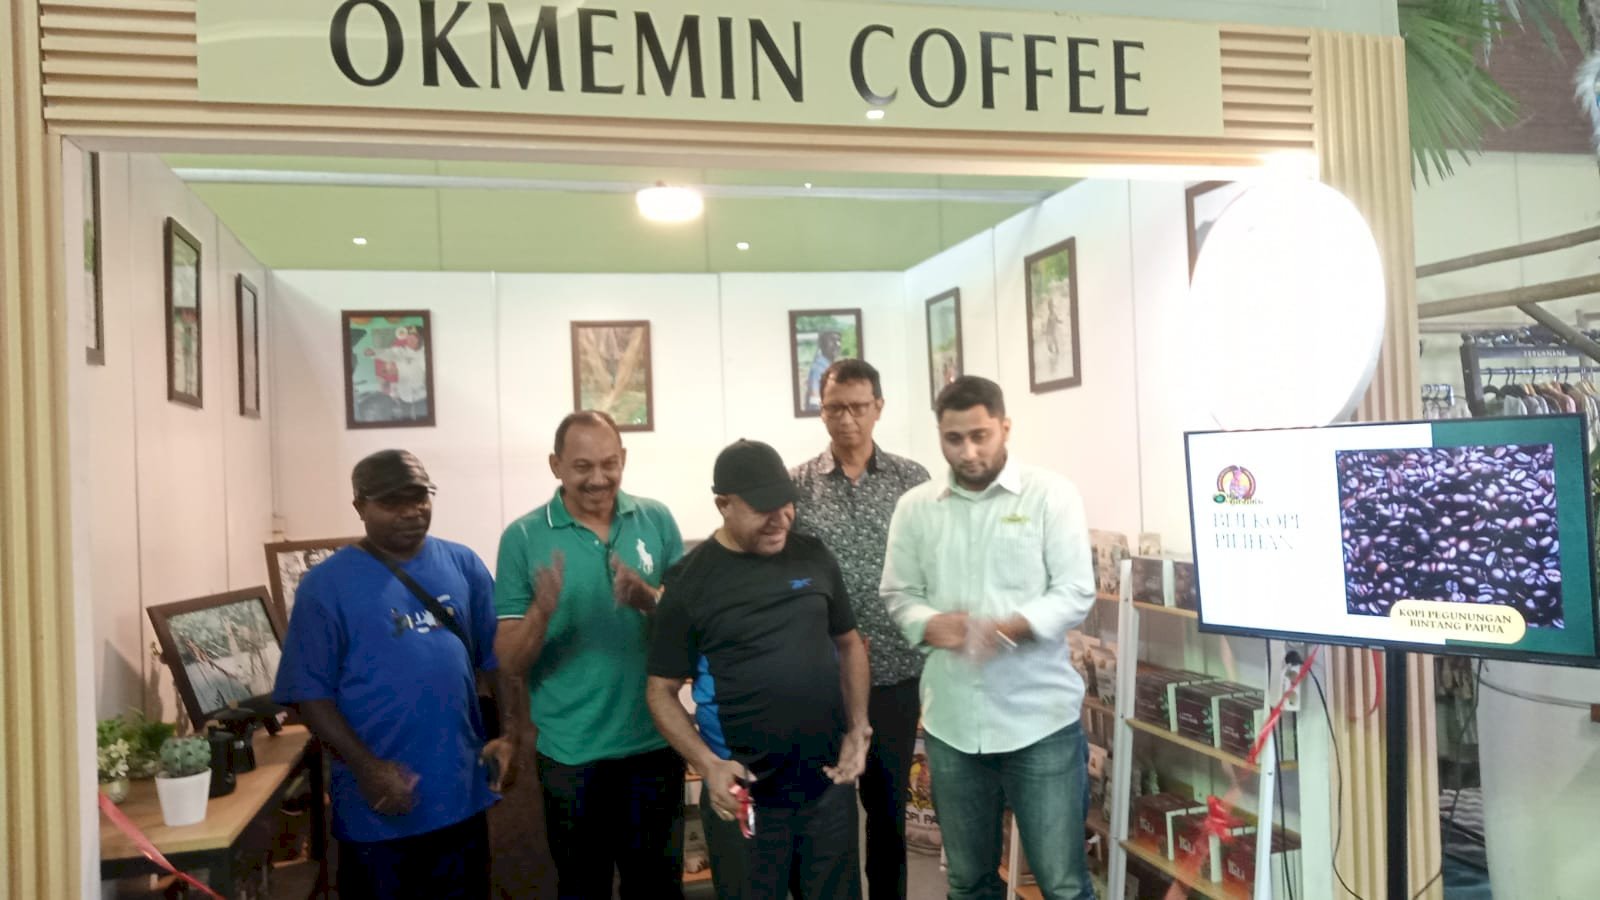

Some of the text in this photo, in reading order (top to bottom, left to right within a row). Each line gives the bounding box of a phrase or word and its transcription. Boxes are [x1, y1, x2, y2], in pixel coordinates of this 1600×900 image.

[329, 0, 1150, 117] OKMEMIN COFFEE
[1399, 608, 1512, 624] KOPI PEGUNUNGAN
[1409, 618, 1504, 634] BINTANG PAPUA
